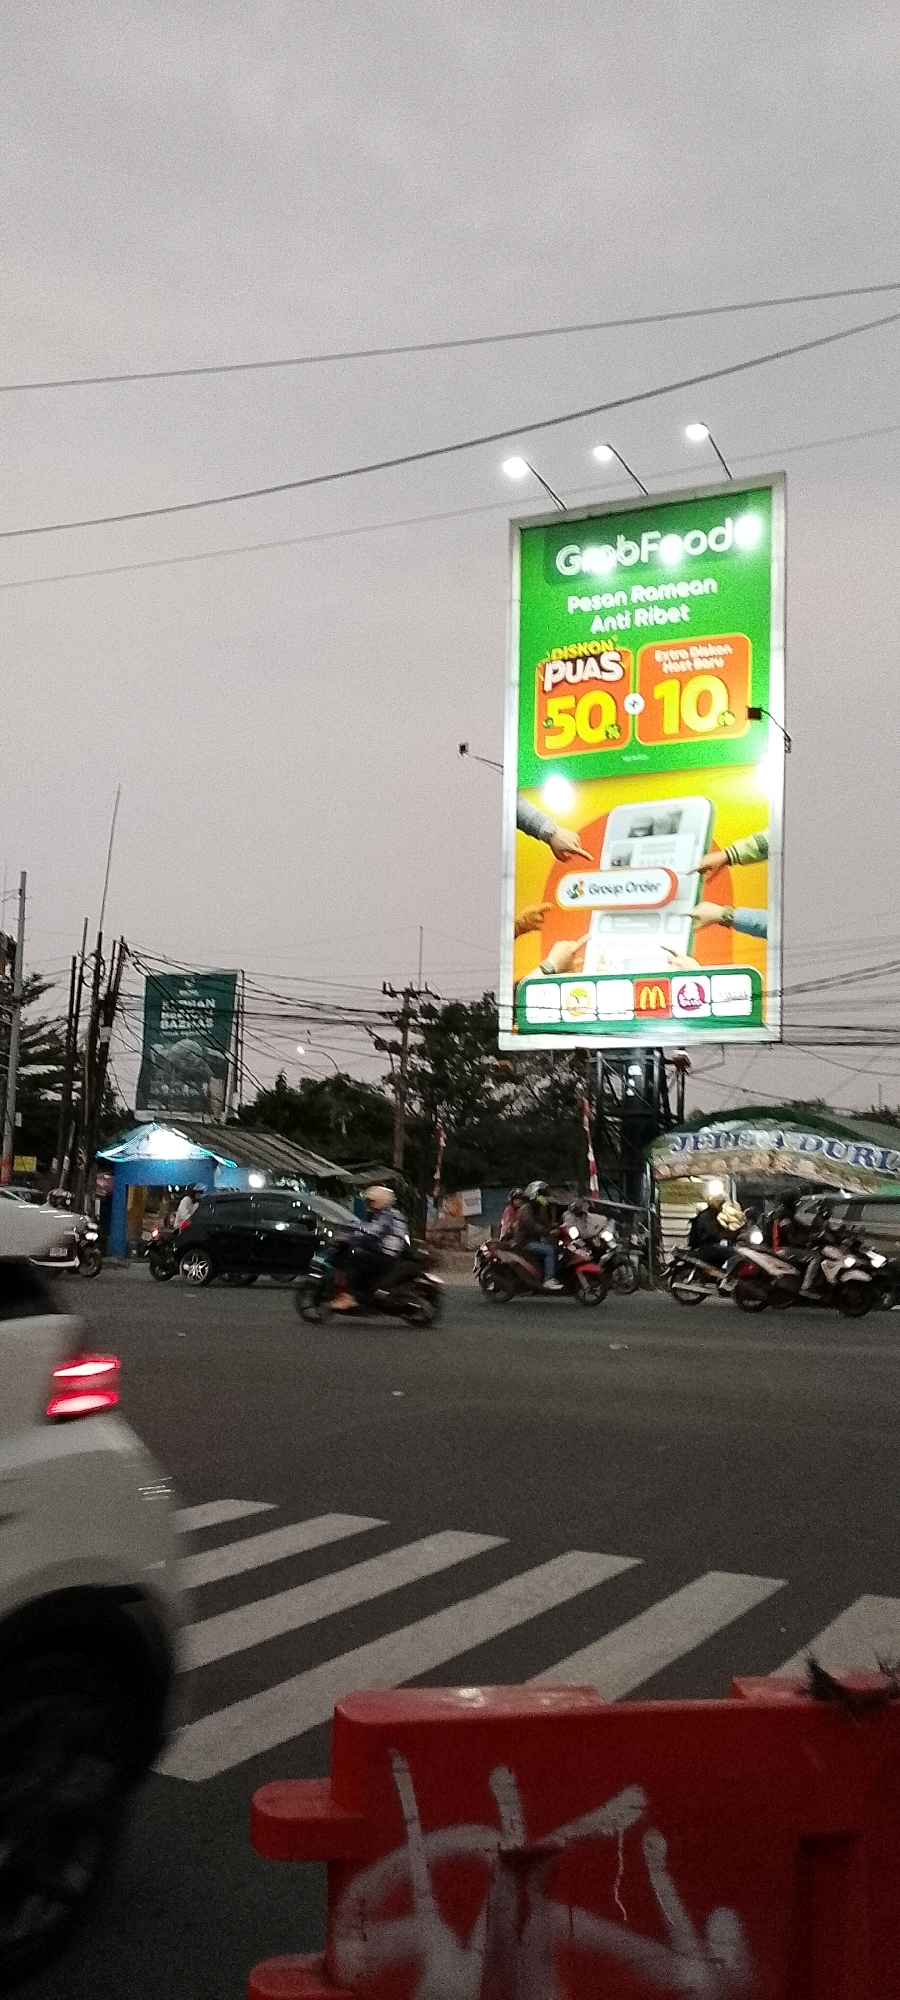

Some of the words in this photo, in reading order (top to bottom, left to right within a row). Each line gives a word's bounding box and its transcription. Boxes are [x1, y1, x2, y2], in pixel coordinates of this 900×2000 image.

[555, 517, 734, 576] GabFod
[567, 590, 628, 614] Pesan
[630, 577, 718, 604] Ramean
[589, 610, 632, 634] Anti
[634, 603, 691, 628] Ribet
[551, 639, 615, 661] DISKON
[543, 651, 624, 693] PUAS
[588, 882, 624, 898] Group
[625, 879, 659, 894] Order
